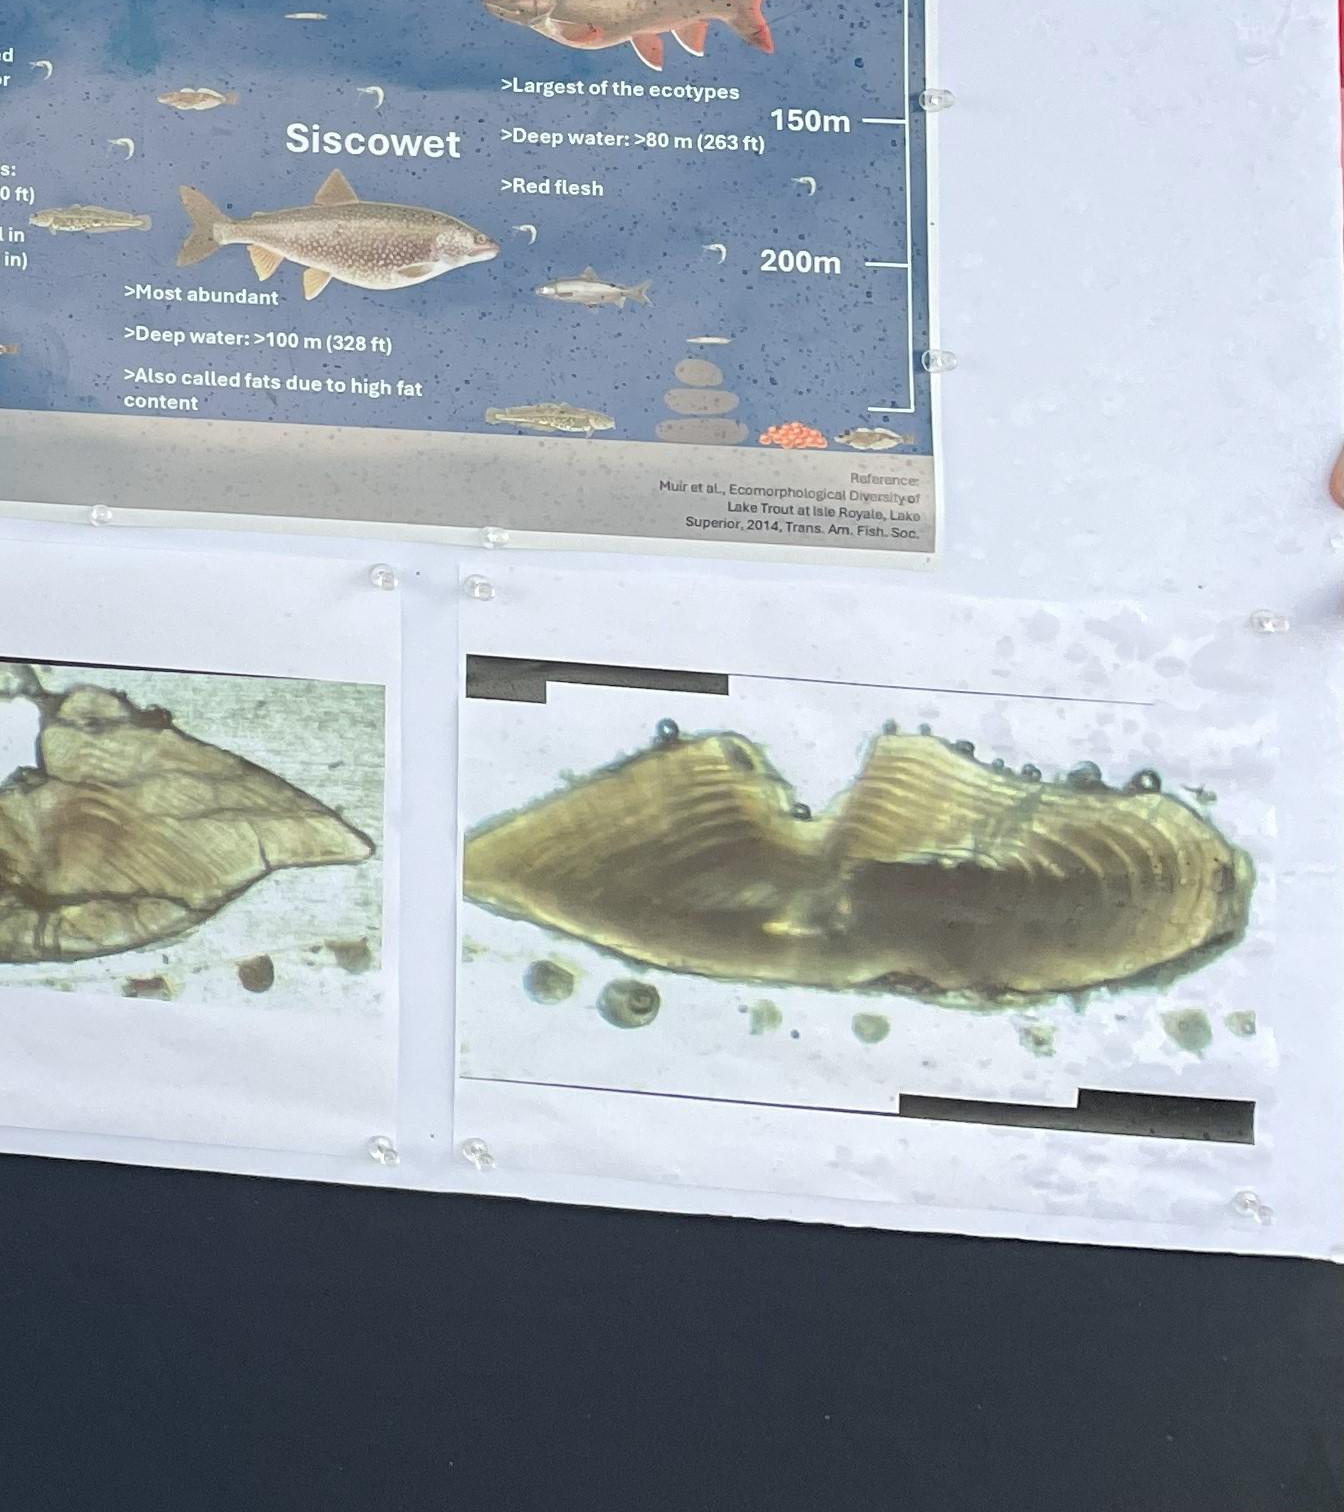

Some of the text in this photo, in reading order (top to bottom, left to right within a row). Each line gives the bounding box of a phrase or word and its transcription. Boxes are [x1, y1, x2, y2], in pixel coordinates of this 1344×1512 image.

[500, 76, 740, 103] >Largest of the ecotypes
[770, 108, 851, 134] 150m
[285, 122, 462, 160] Siscowet
[500, 177, 604, 197] >Red flesh
[759, 248, 841, 275] 200m
[658, 479, 689, 493] Muir
[690, 482, 704, 494] et
[729, 483, 847, 503] Ecomorphological
[849, 489, 906, 506] Diversity
[906, 492, 921, 505] of
[727, 500, 922, 523] Lake Trout at Isle Royale, Lake
[685, 515, 920, 540] Superior, 2014, Trans. Am. Fish. Soc.
